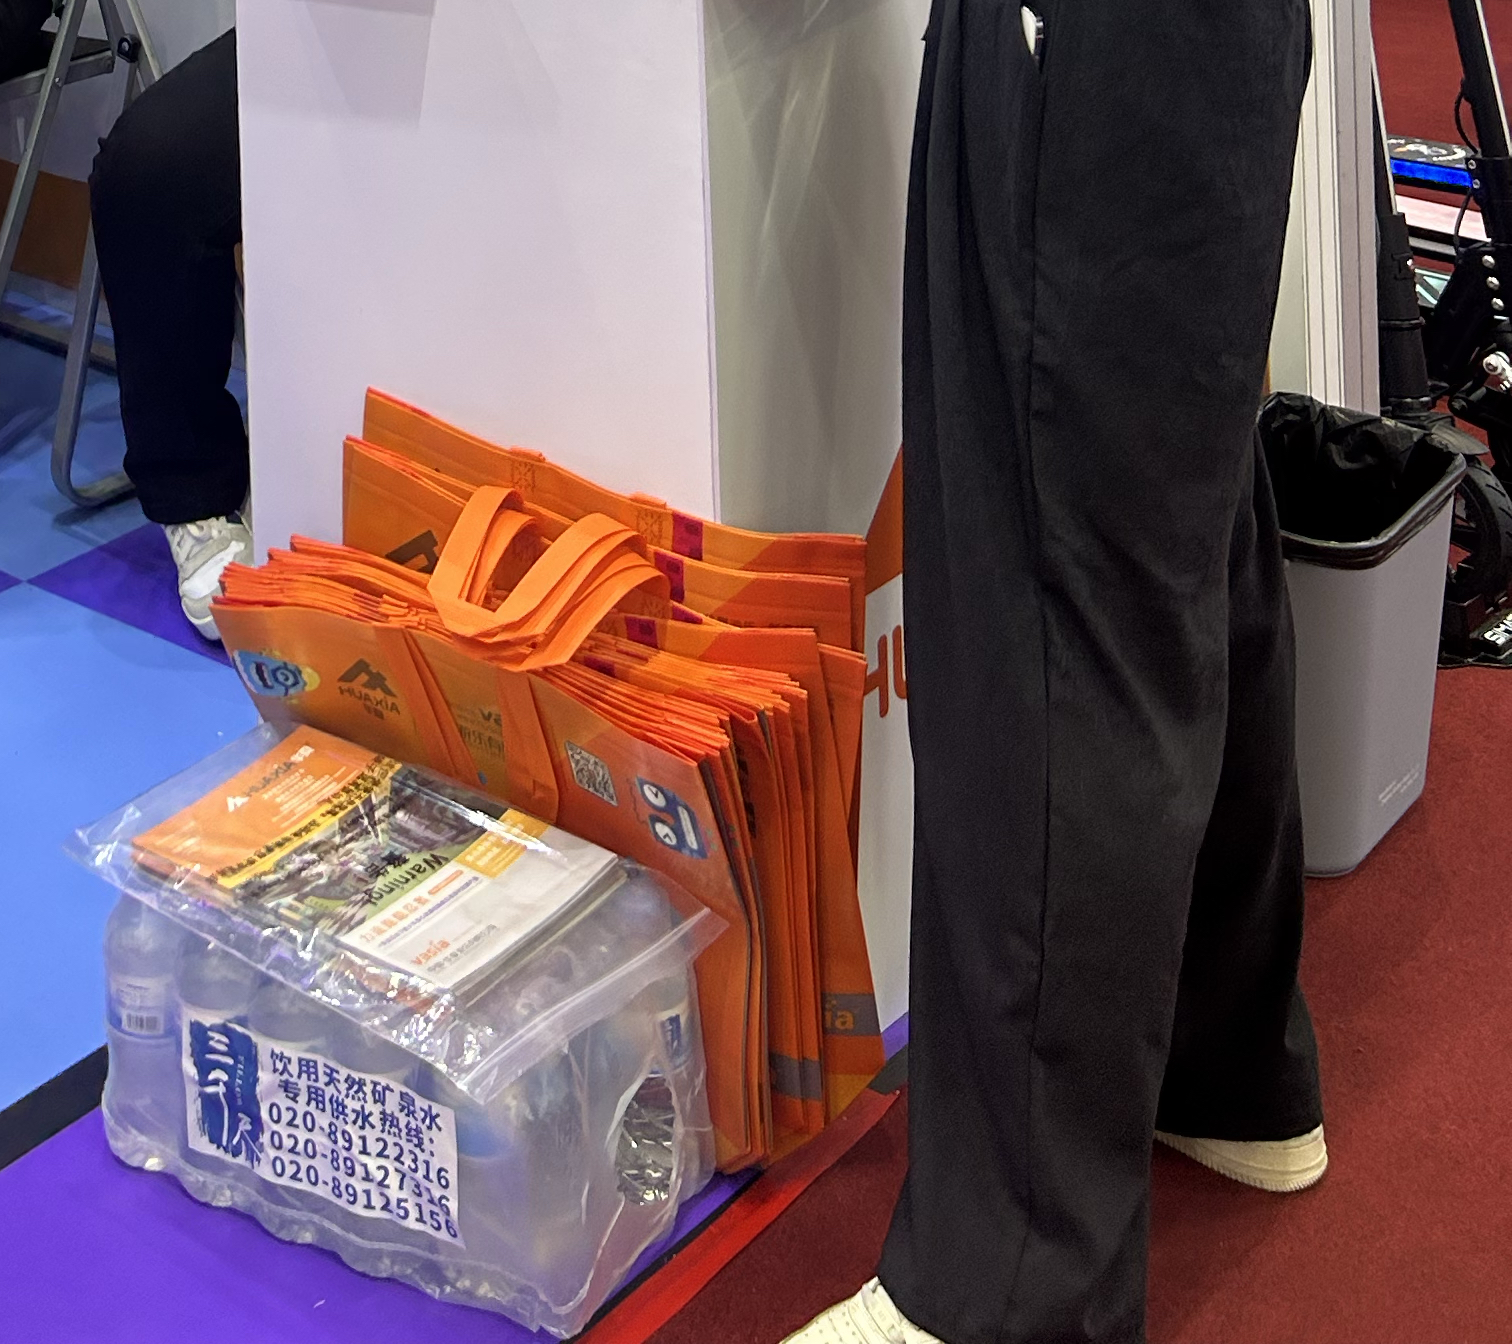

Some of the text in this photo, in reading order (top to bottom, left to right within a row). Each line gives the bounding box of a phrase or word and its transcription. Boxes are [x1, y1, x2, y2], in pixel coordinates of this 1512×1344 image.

[270, 1047, 442, 1132] 饮用天然矿泉水
[268, 1101, 451, 1190] 020-89122316
[270, 1129, 452, 1217] 020-89127316
[272, 1156, 459, 1239] 020-89125156
